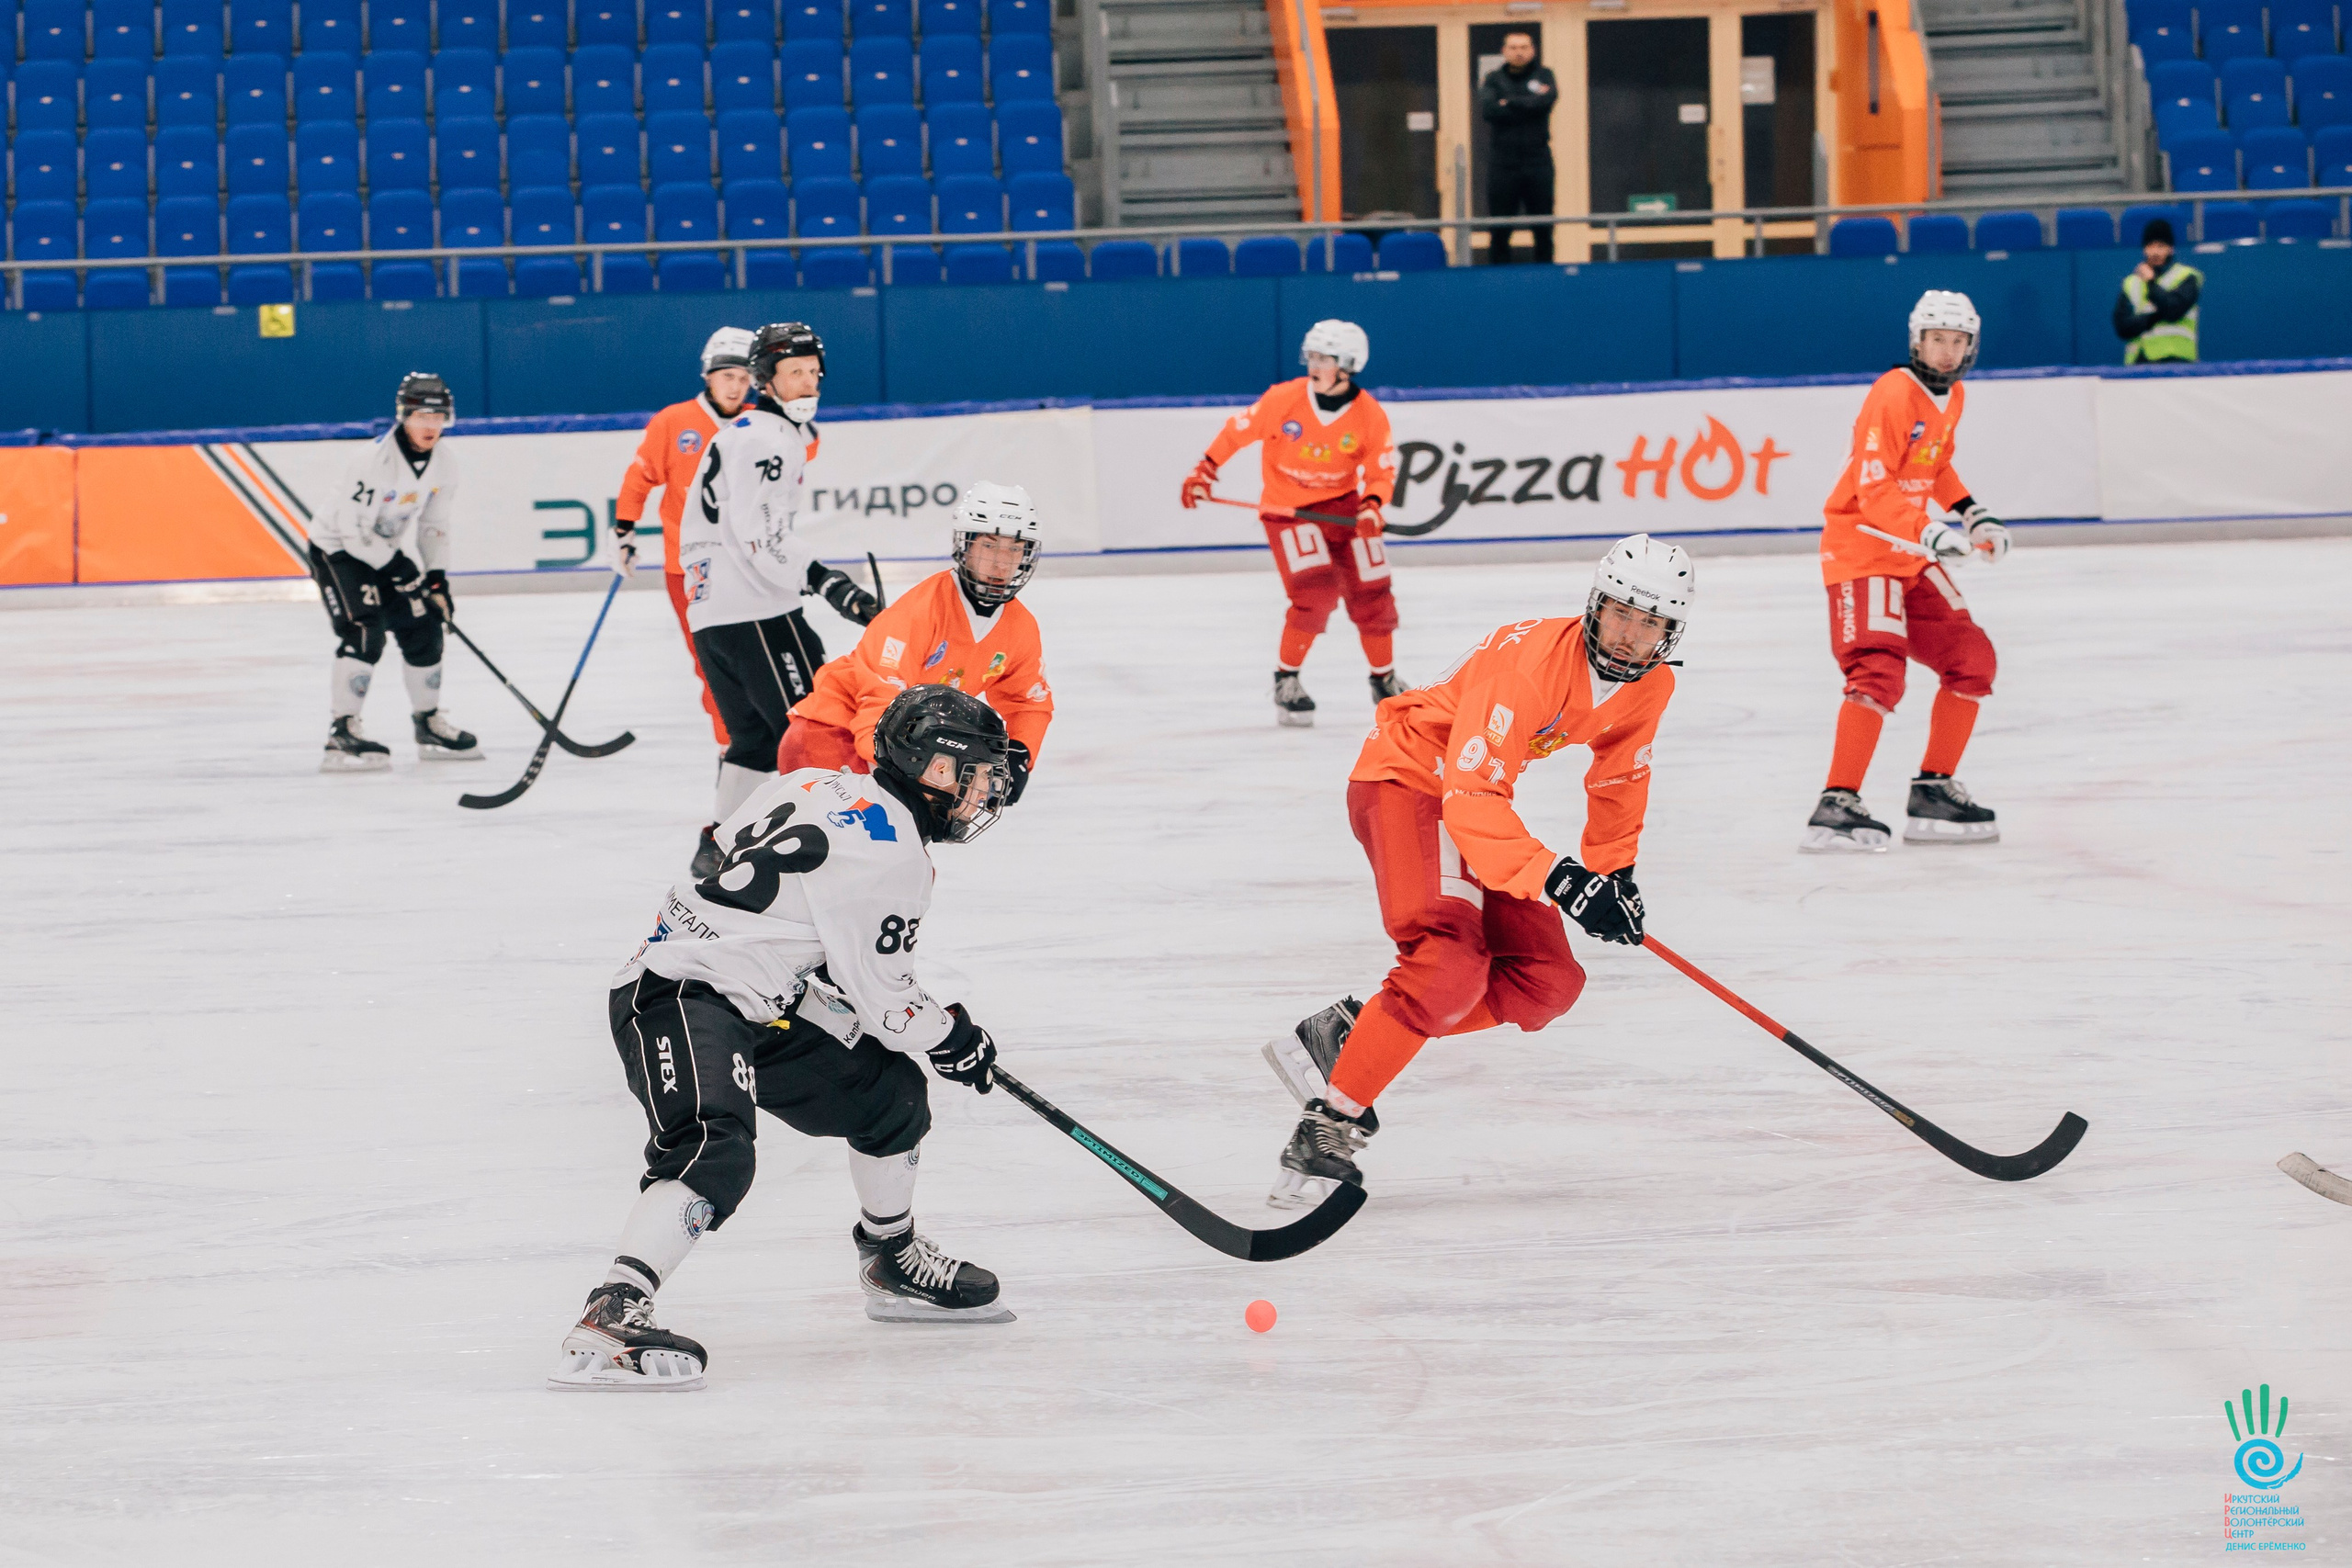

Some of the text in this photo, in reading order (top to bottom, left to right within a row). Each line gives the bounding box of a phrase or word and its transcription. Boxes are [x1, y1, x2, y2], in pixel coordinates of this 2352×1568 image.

[755, 455, 784, 484] 78
[1390, 440, 1605, 508] Pizza
[351, 479, 376, 507] 21
[812, 482, 958, 518] гидро
[1630, 584, 1661, 602] Reebok
[935, 737, 968, 751] CCM
[695, 801, 831, 914] 88
[656, 1036, 678, 1094] STEX
[934, 1030, 990, 1073] CCM
[732, 1053, 757, 1105] 88
[1074, 1127, 1141, 1179] OPTIMIZED
